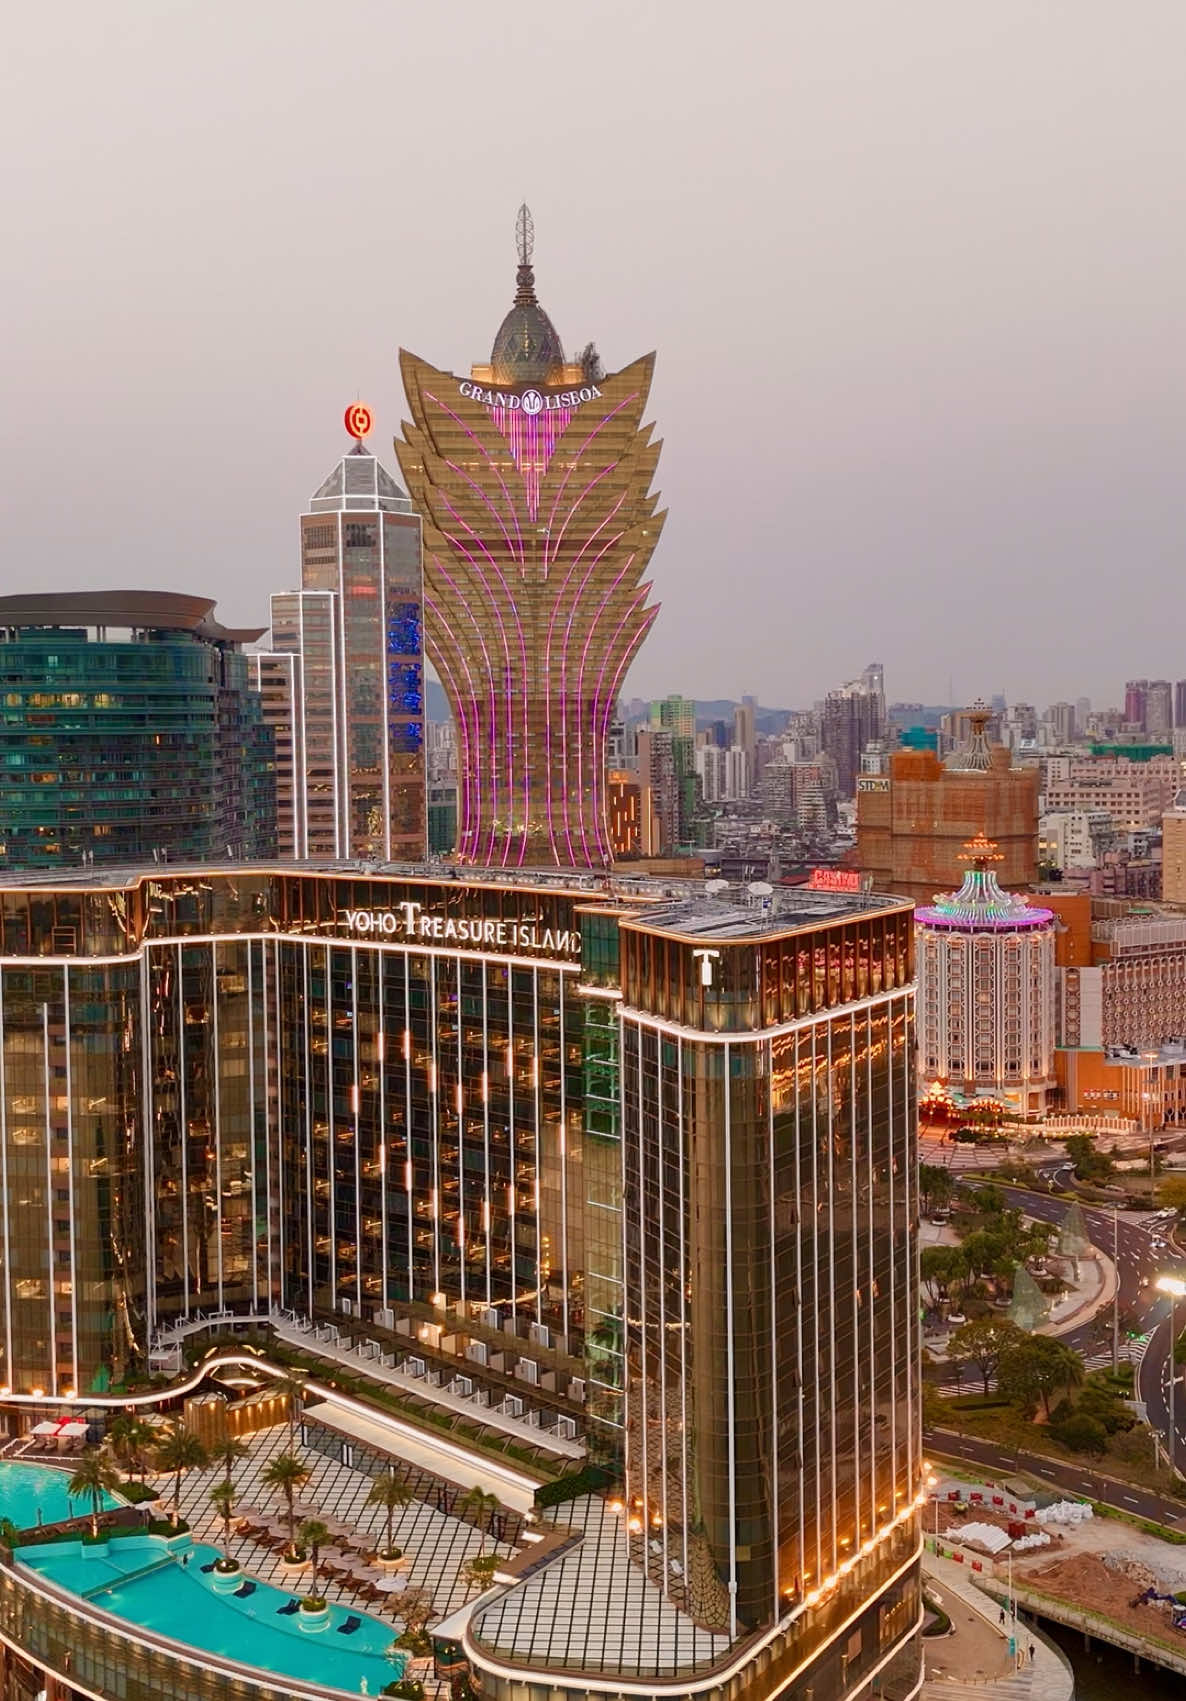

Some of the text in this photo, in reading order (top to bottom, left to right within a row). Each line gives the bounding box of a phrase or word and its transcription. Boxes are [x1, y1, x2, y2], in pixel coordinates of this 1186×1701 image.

[458, 382, 602, 410] GRAND LISBOA
[346, 909, 397, 934] YOHO
[400, 902, 508, 945] TREASURE
